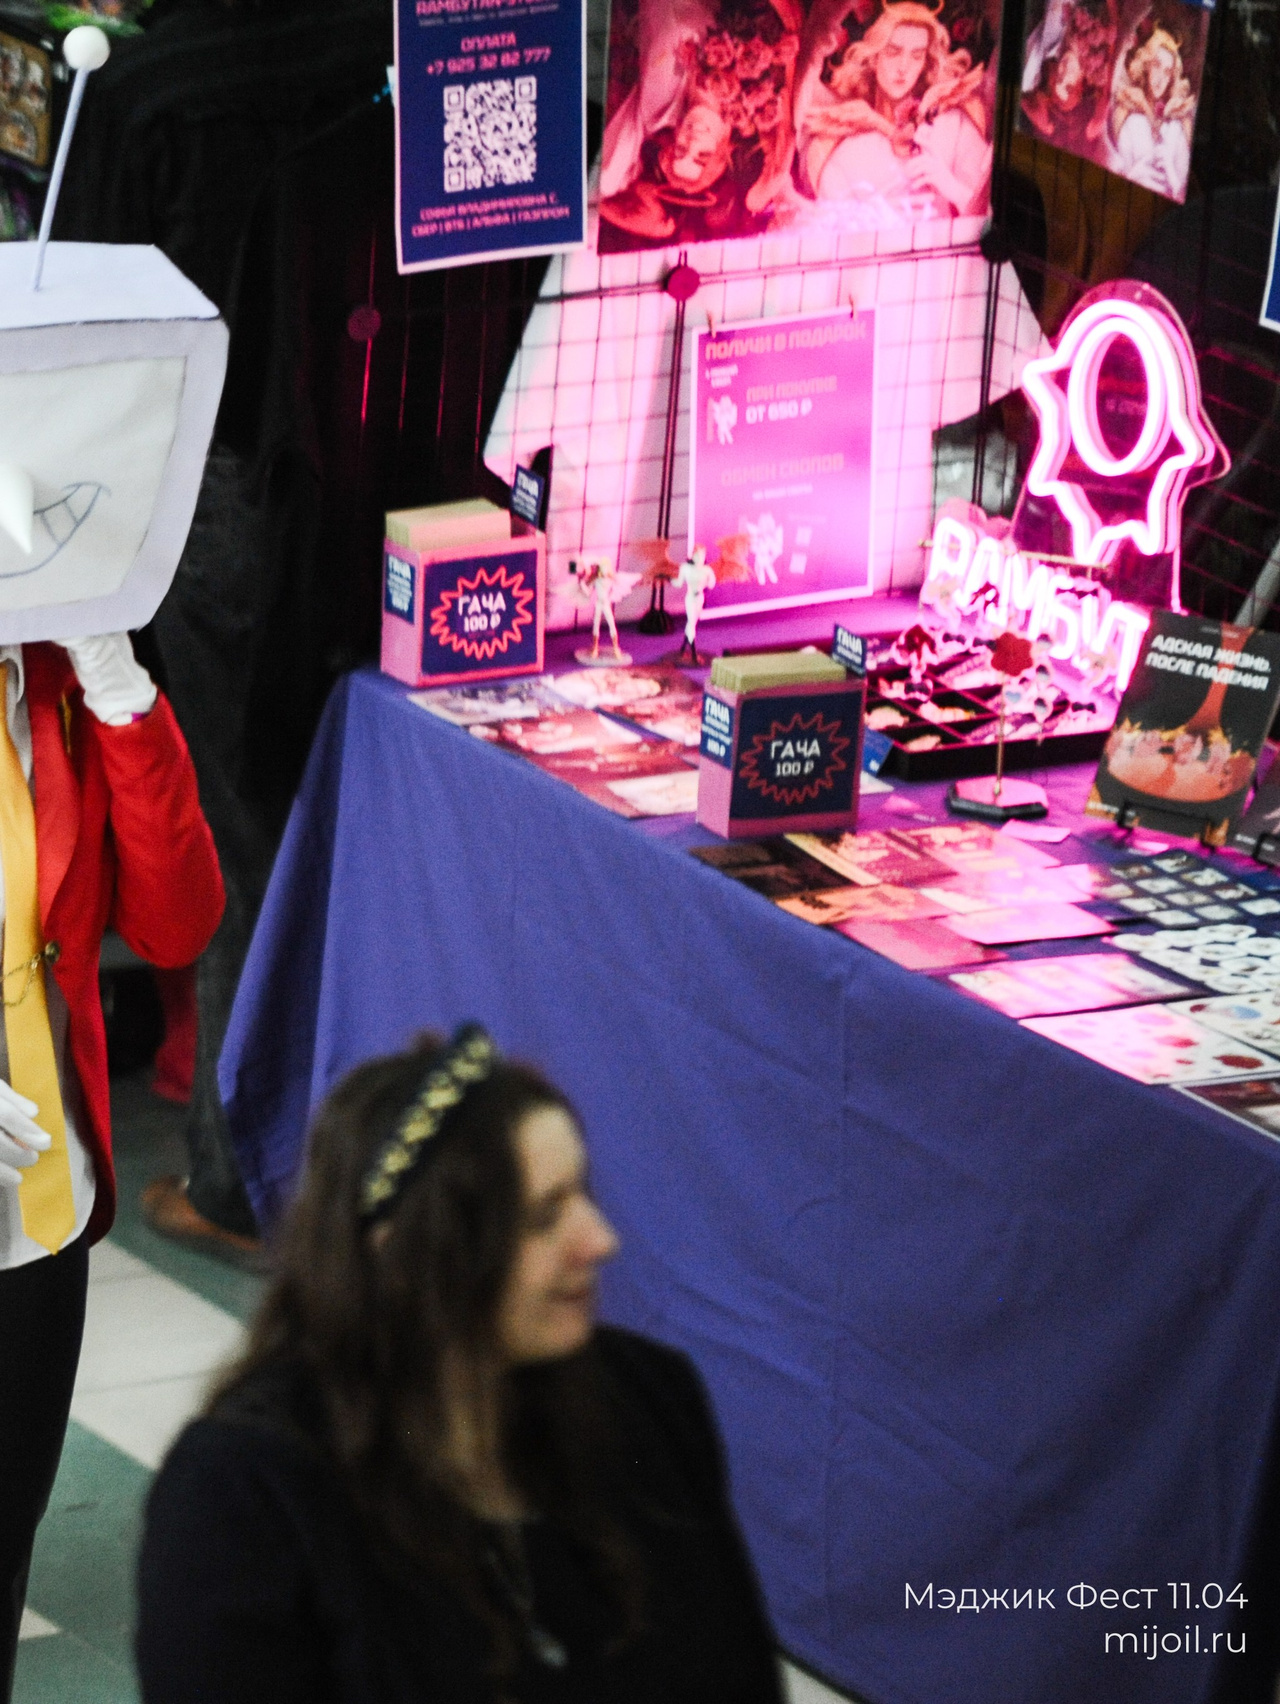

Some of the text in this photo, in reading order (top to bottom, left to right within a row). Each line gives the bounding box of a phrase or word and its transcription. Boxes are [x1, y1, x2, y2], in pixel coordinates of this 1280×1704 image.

[458, 591, 507, 616] ГАЧА
[463, 615, 487, 633] 100
[1151, 634, 1214, 660] АДСКАЯ
[1144, 652, 1269, 691] ПОСЛЕ ПАДЕНИЯ
[705, 697, 730, 726] ГАЧА
[770, 737, 821, 760] ГАЧА
[775, 760, 800, 777] 100
